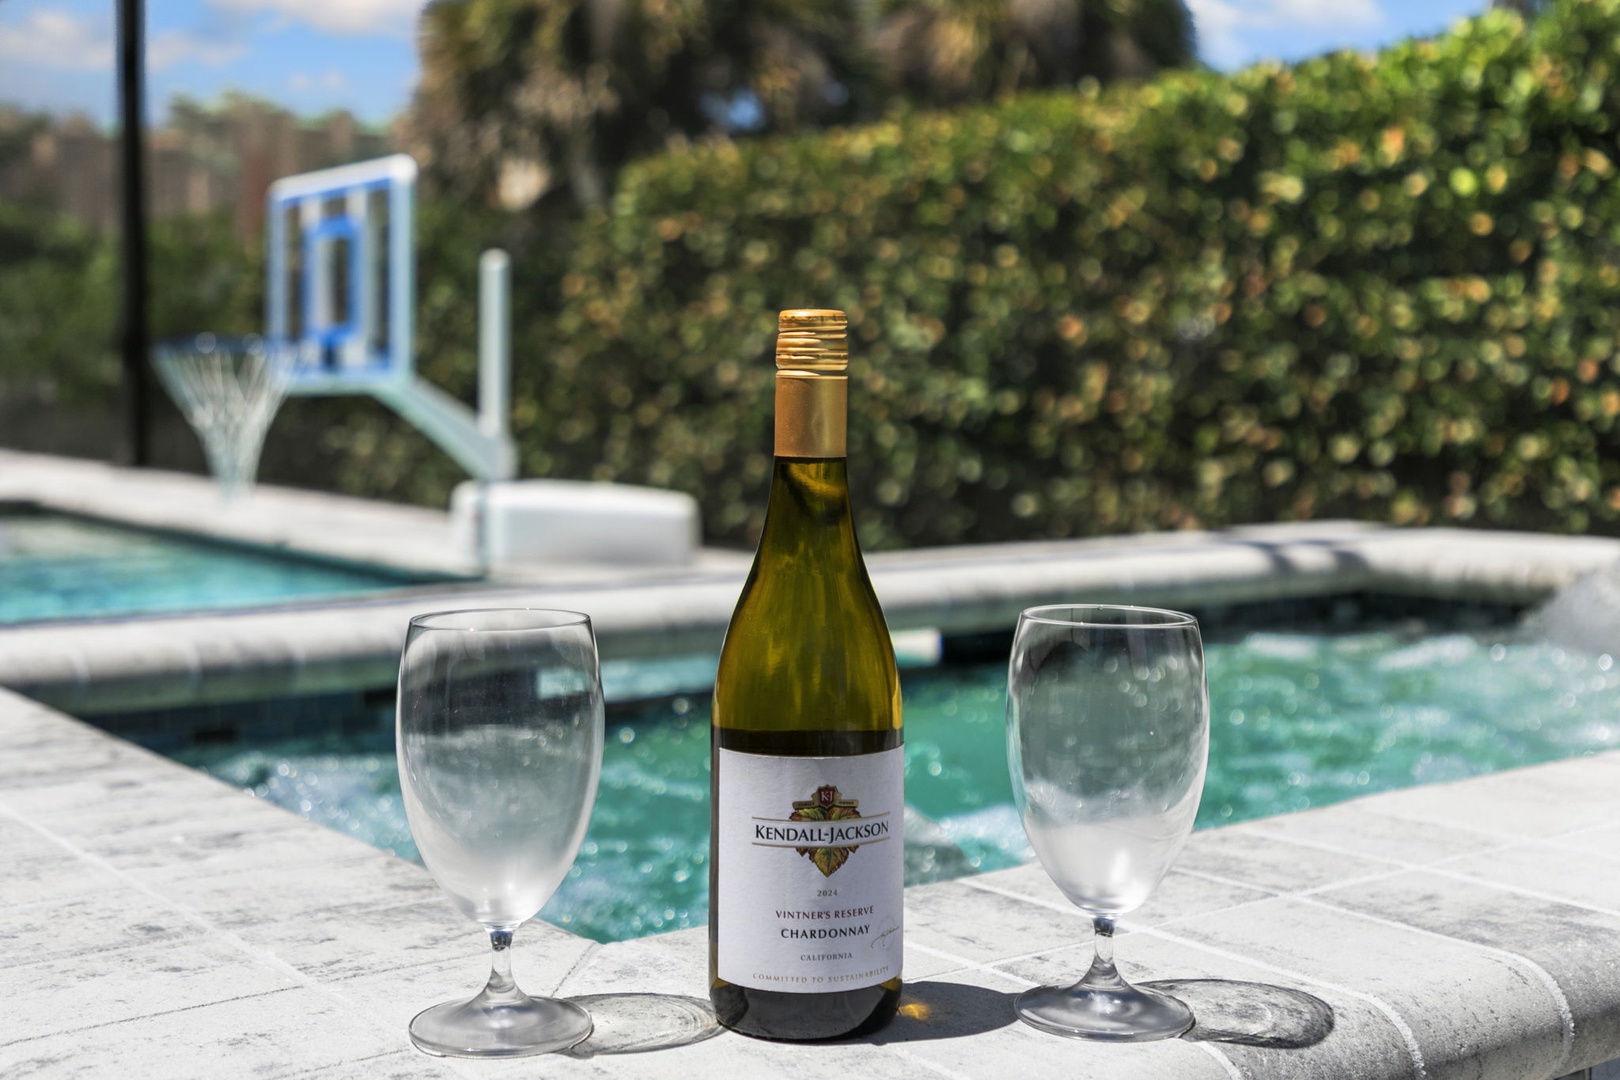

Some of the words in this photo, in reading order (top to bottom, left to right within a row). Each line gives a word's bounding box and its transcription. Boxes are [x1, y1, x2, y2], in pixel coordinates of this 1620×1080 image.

[755, 820, 889, 844] KENDALL-JACKSON
[817, 889, 838, 897] 2024
[775, 910, 831, 920] VINTNER'S
[834, 906, 874, 919] RESERVE
[780, 924, 870, 939] CHARDONNAY
[800, 952, 853, 961] CALIFORNIA
[753, 973, 808, 984] COMMITTED
[812, 976, 824, 984] TO
[828, 965, 889, 984] SUSTAINABILITY
